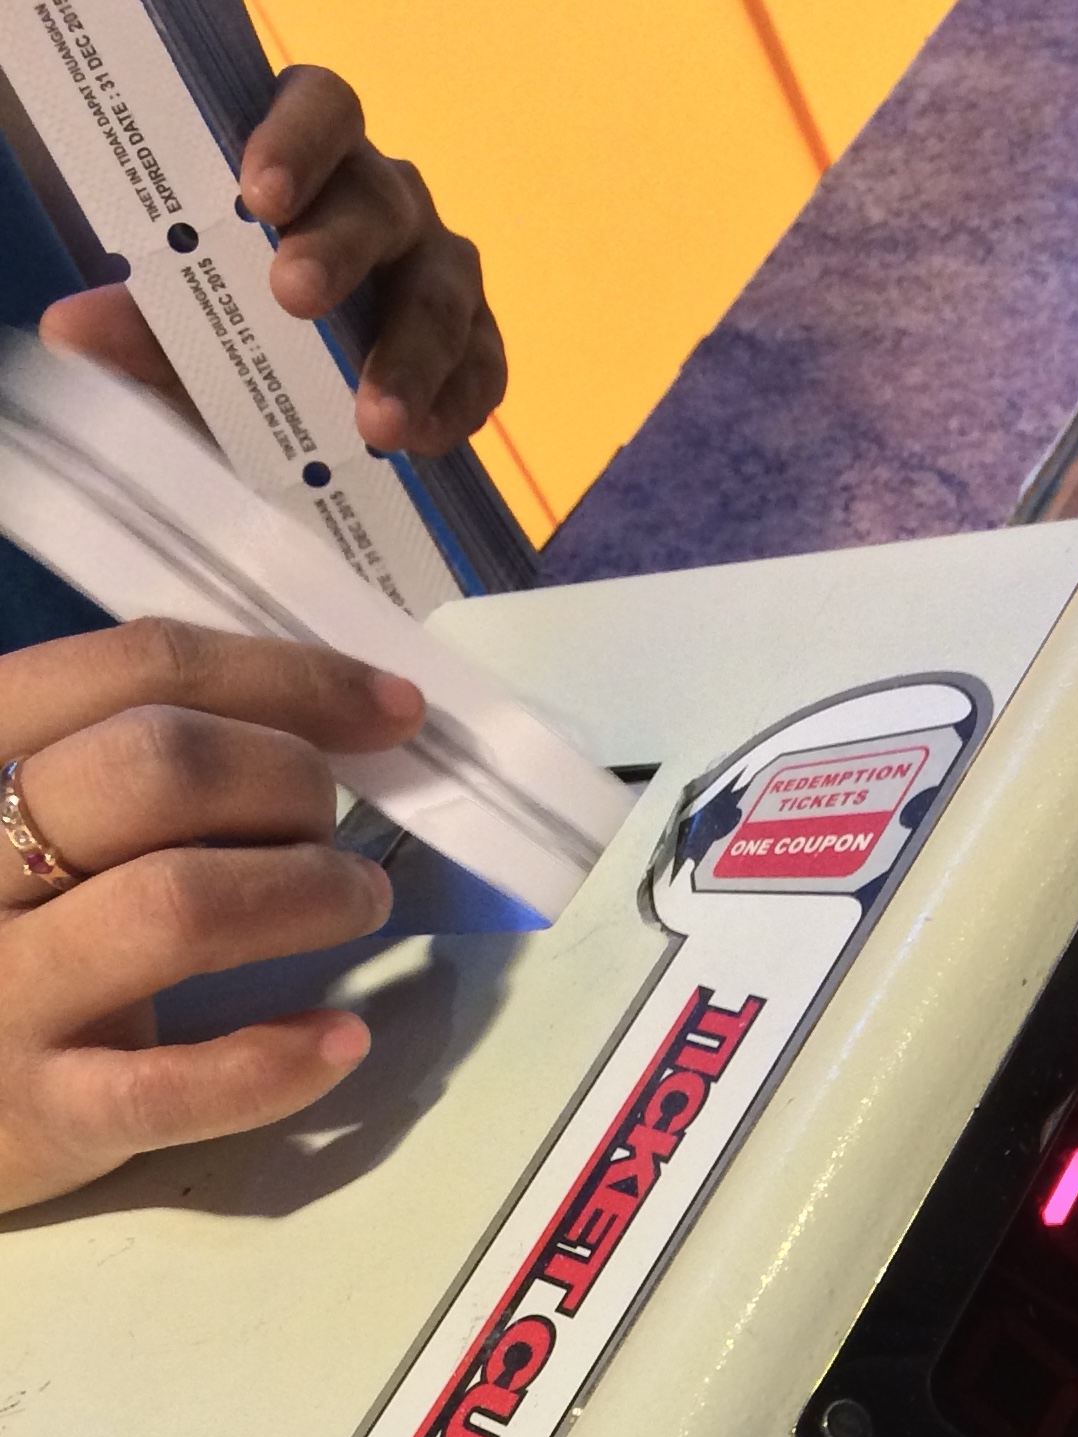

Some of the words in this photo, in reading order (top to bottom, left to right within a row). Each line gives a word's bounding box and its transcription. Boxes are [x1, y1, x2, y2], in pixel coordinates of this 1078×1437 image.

[34, 3, 86, 83] DIUANGKAN
[75, 34, 103, 71] DEC
[95, 72, 115, 92] 31
[78, 86, 110, 127] DAPAT
[111, 102, 145, 145] DATE
[103, 126, 131, 167] TIDAK
[125, 166, 144, 184] INI
[137, 147, 182, 214] EXPIRED
[135, 186, 161, 222] TIKET
[197, 257, 227, 292] 2015
[218, 293, 245, 326] DEC
[237, 327, 255, 345] 31
[221, 339, 251, 378] DAPAT
[252, 352, 282, 393] DATE
[274, 394, 317, 453] EXPIRED
[770, 763, 913, 794] REDEMPTION
[778, 789, 869, 812] TICKETS
[730, 839, 771, 857] ONE
[774, 832, 874, 855] COUPON
[528, 984, 768, 1319] TICKET
